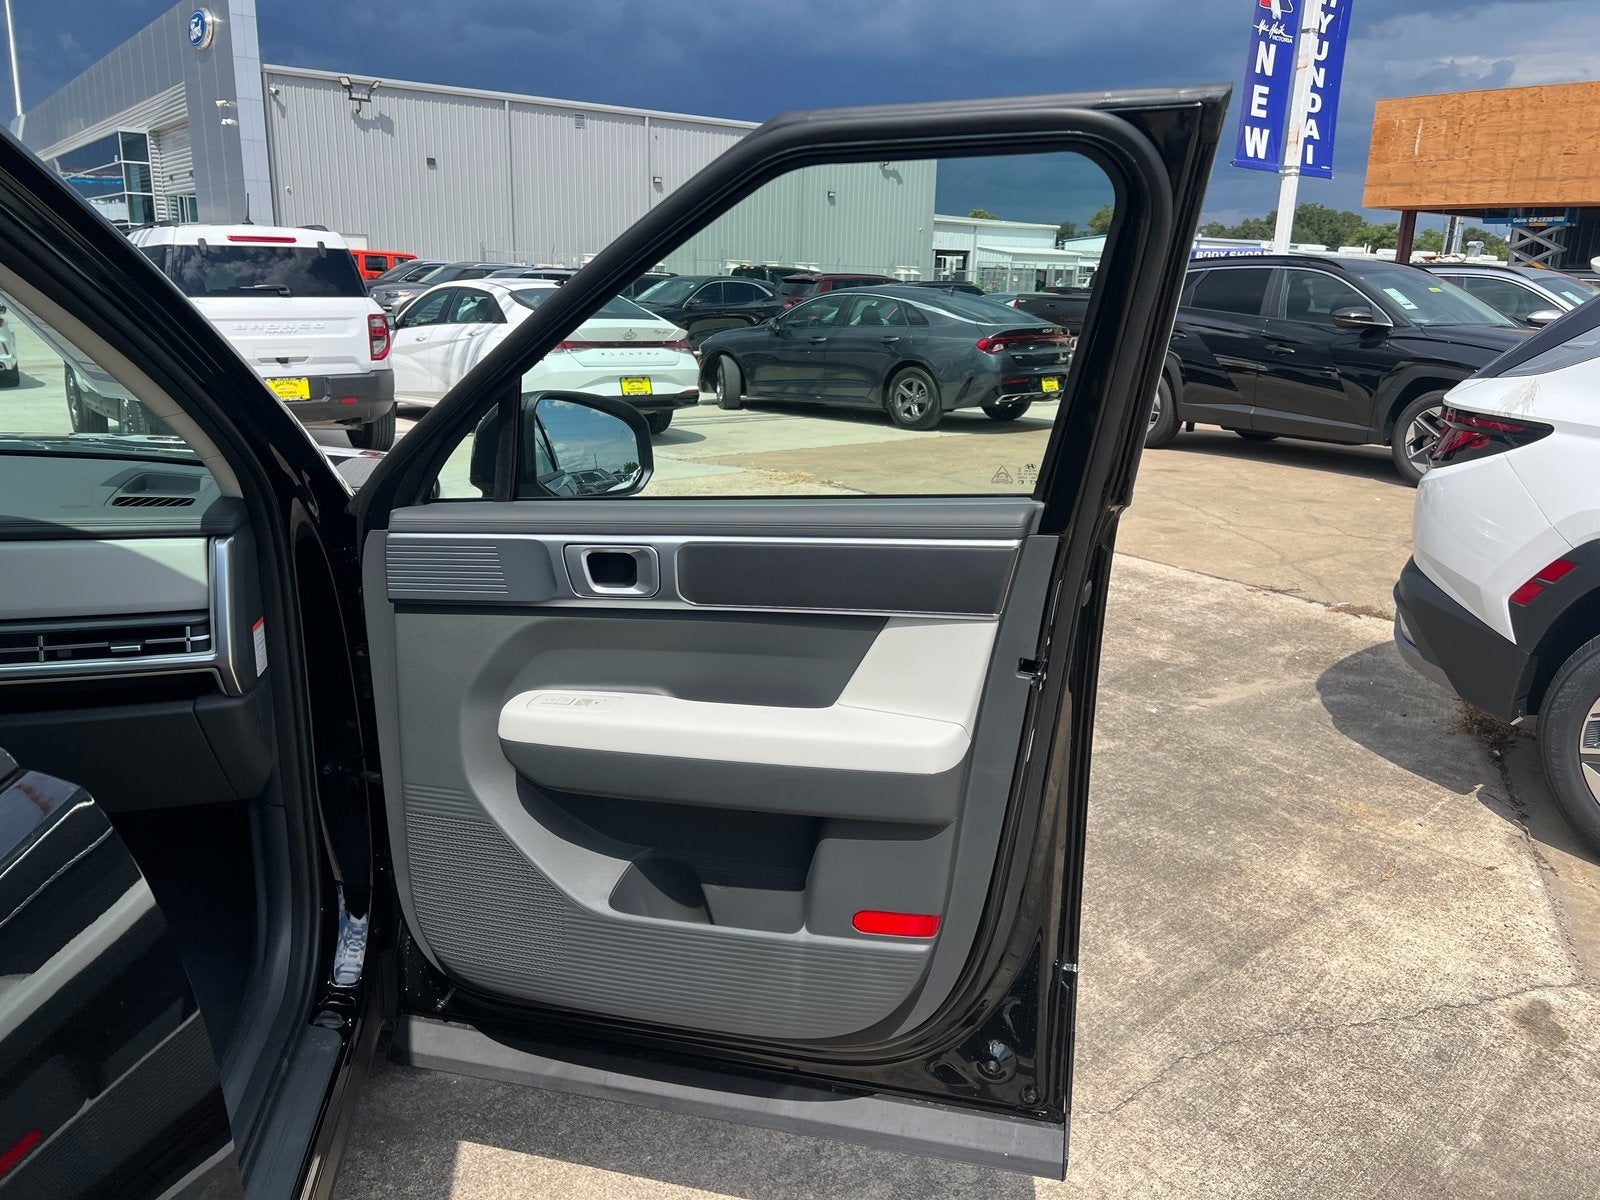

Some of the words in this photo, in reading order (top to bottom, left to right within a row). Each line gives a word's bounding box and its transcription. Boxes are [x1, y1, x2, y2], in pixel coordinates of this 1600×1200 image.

[1272, 35, 1293, 43] VICTORIA
[1244, 41, 1276, 160] NEW
[1196, 251, 1227, 259] BODY
